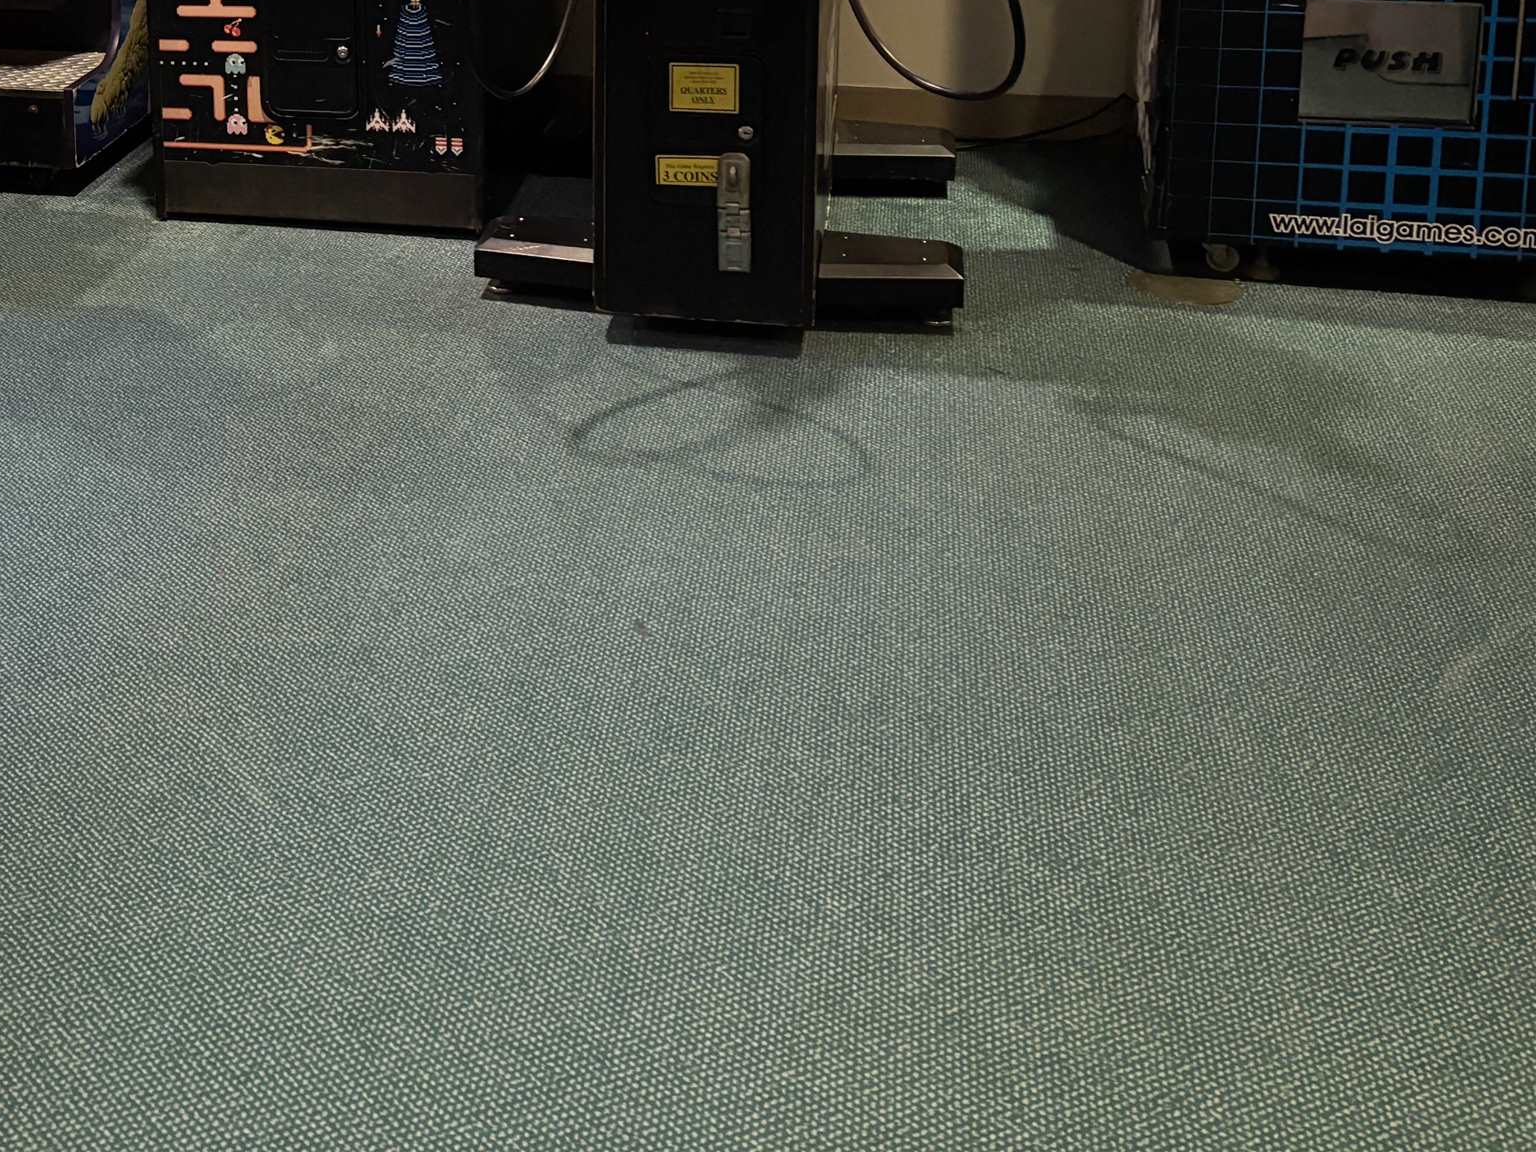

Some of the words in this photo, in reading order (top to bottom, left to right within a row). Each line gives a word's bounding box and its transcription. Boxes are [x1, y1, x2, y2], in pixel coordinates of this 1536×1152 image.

[1333, 49, 1443, 74] PUSH
[680, 86, 727, 95] QUARTERS
[691, 96, 715, 104] ONLY
[663, 170, 670, 181] 3
[674, 170, 718, 182] COINS
